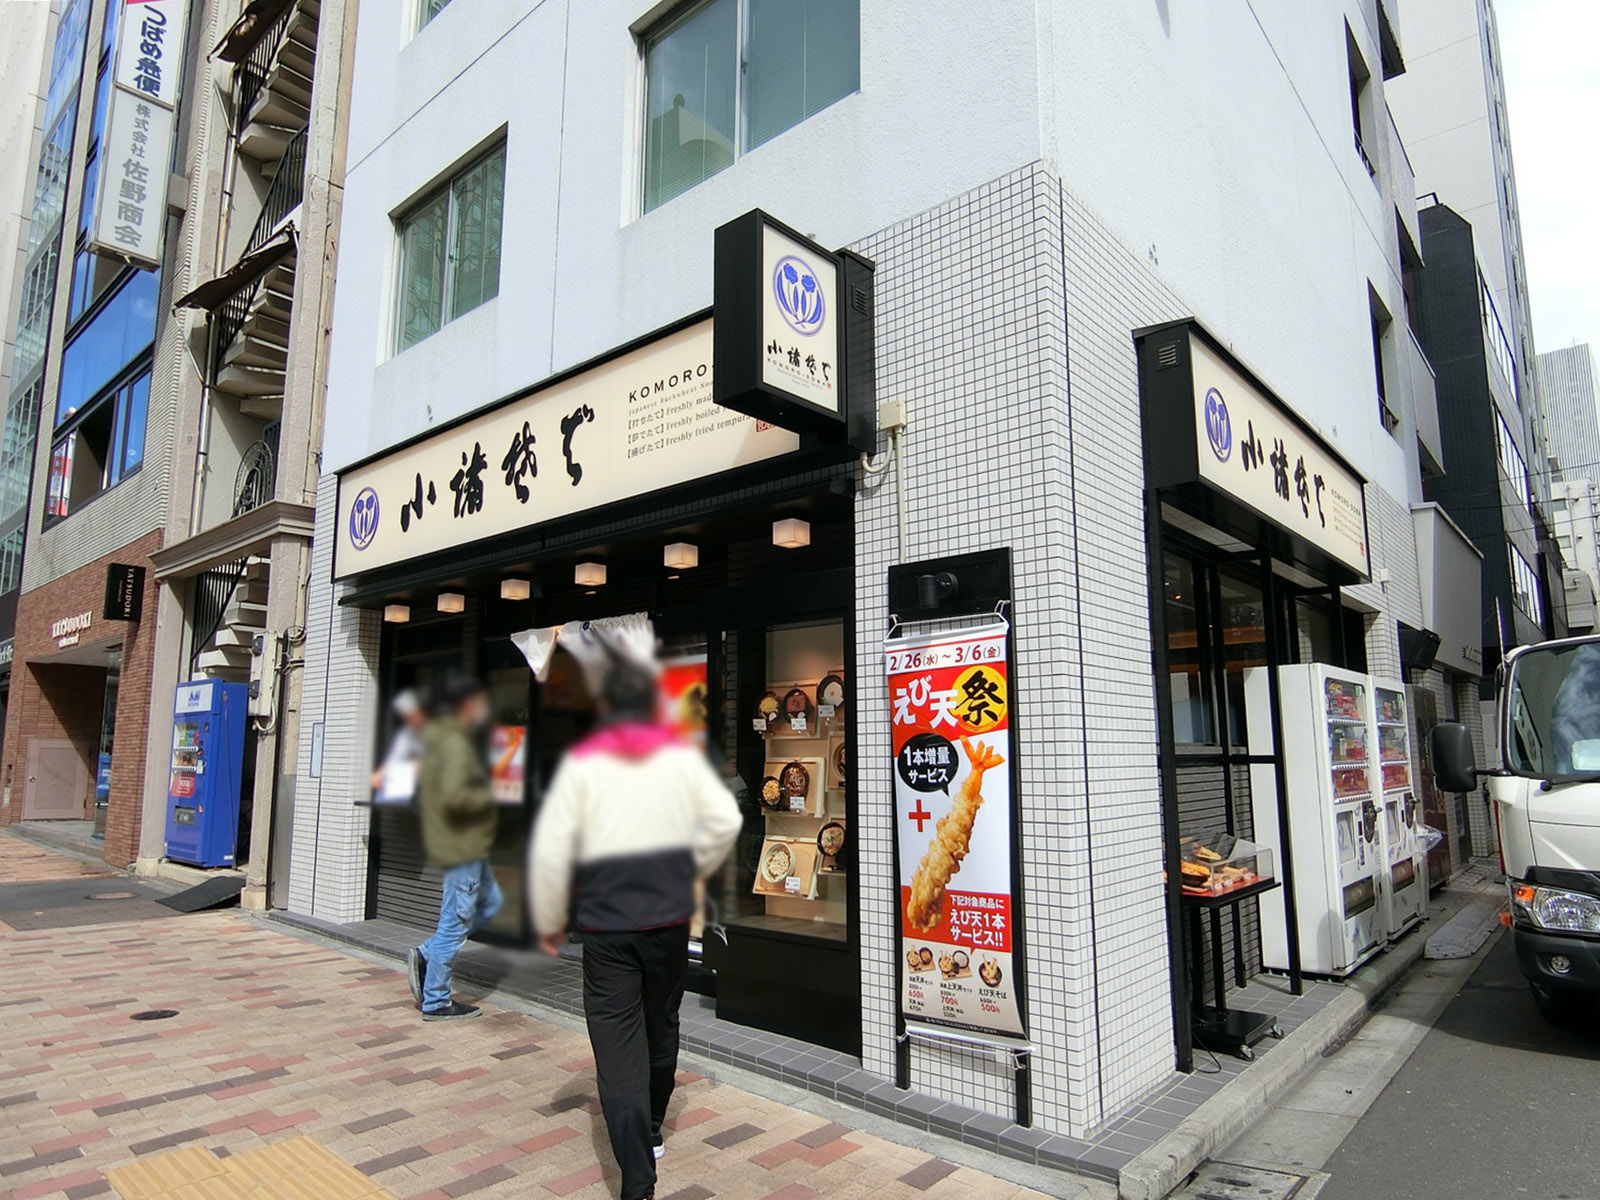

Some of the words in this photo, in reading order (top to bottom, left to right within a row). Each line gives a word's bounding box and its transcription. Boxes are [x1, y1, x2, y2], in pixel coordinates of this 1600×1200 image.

[133, 4, 167, 98] つばめ急便
[629, 364, 714, 403] KOMORO
[666, 400, 693, 416] Freshly
[695, 394, 713, 406] mad
[666, 415, 693, 431] Freshly
[695, 406, 721, 421] boiled
[666, 430, 693, 446] Freshly
[694, 424, 715, 437] fried
[123, 567, 135, 618] YATSUDOKI
[903, 745, 951, 766] 1本増量
[908, 768, 949, 784] サービス
[950, 909, 1006, 929] えび天1本
